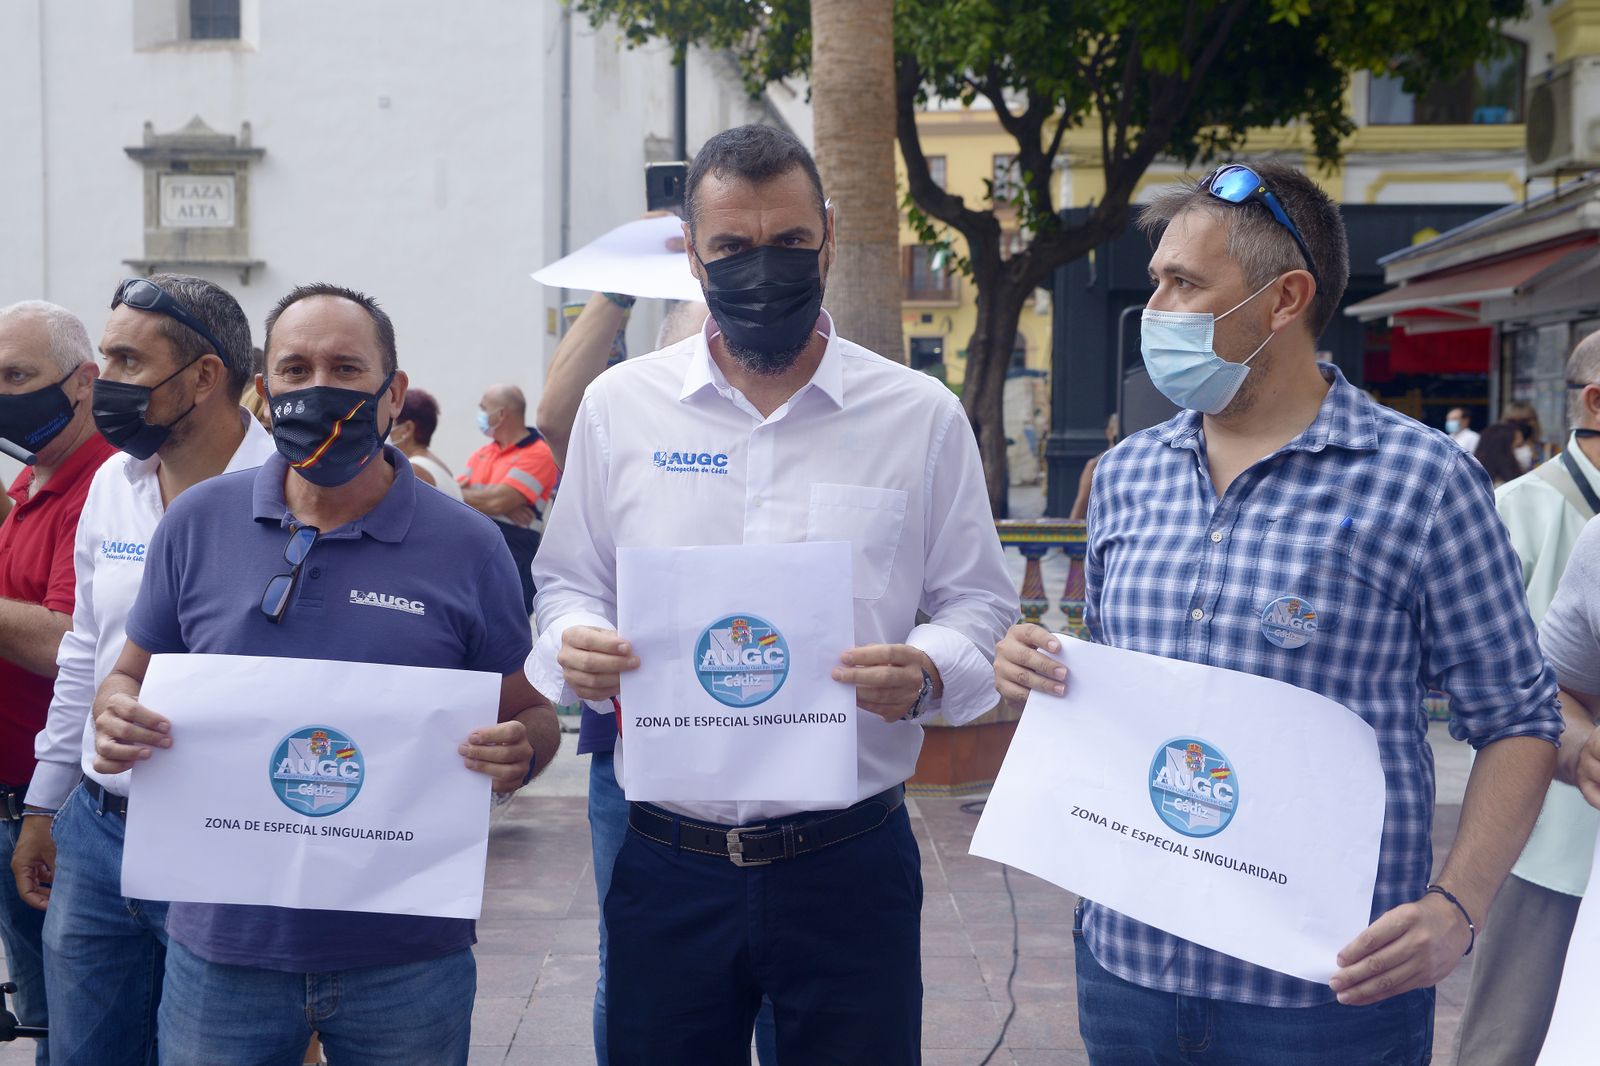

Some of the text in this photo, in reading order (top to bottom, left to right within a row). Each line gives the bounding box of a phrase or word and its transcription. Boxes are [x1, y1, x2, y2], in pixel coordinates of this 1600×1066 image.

[171, 185, 224, 199] PLAZA
[177, 204, 218, 218] ALTA
[668, 452, 728, 467] AUGC
[109, 541, 145, 555] AUGC
[363, 591, 425, 611] AUGC
[1263, 612, 1318, 632] AUGC
[702, 647, 784, 666] AUGC
[723, 674, 761, 687] Cádiz
[635, 712, 847, 727] ZONA DE ESPECIAL SINGULARIDAD
[277, 757, 360, 778] AUGC
[298, 783, 334, 797] Cádiz
[1156, 766, 1234, 803] AUGC
[1174, 797, 1209, 817] Cádiz
[205, 818, 414, 842] ZONA DE ESPECIAL SINGULARIDAD
[1070, 805, 1288, 885] ZONA DE ESPECIAL SINGULARIDAD
